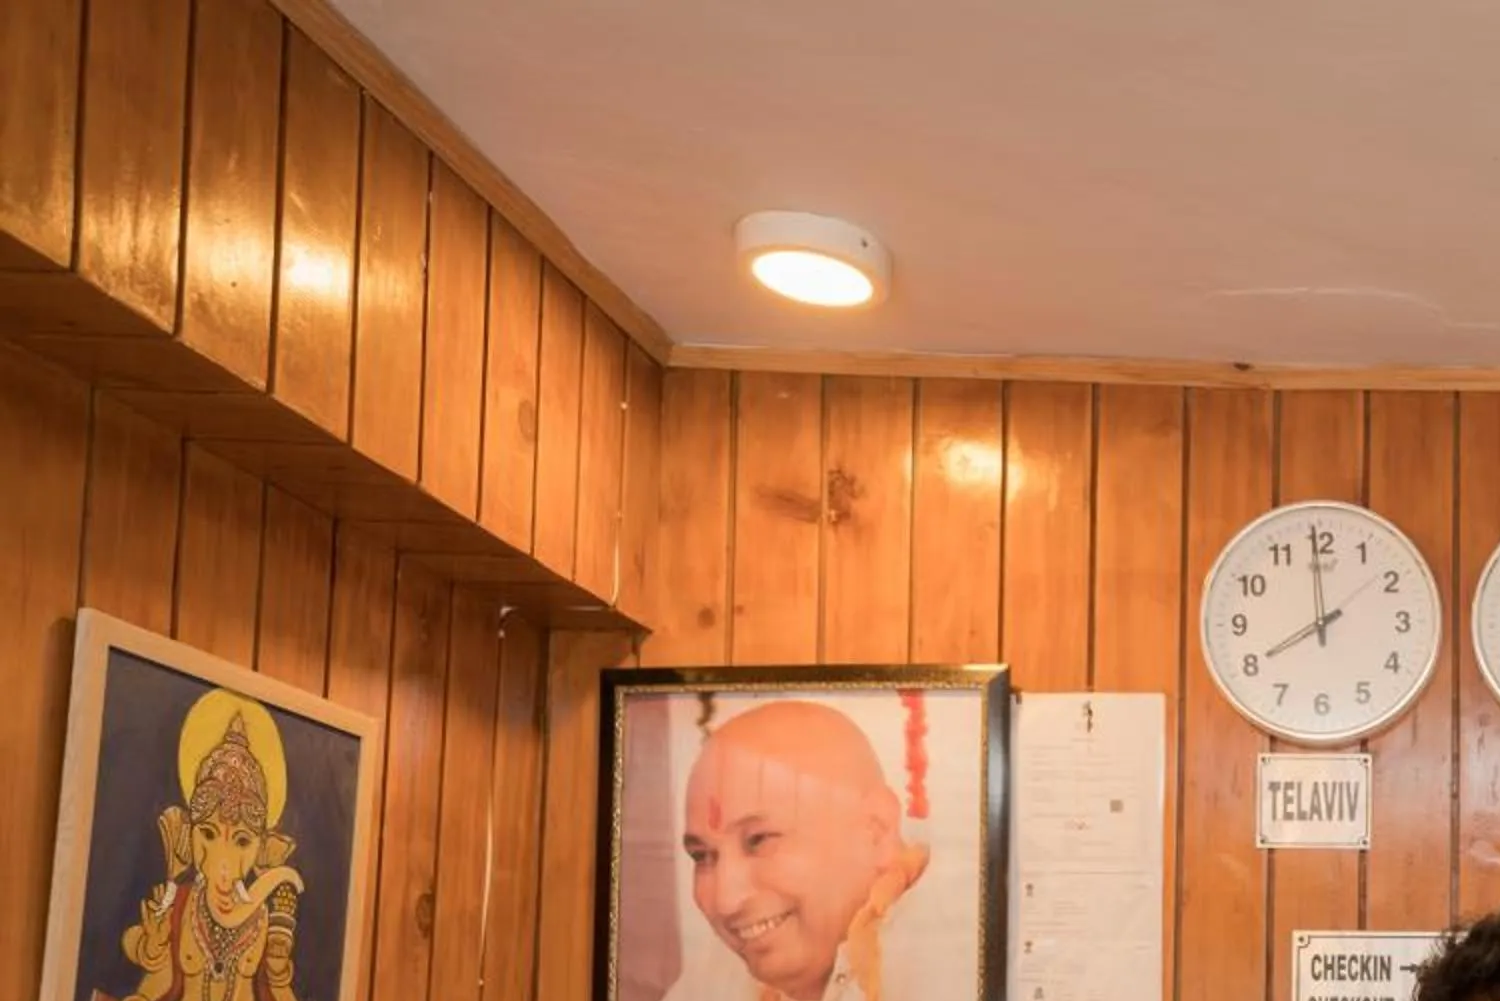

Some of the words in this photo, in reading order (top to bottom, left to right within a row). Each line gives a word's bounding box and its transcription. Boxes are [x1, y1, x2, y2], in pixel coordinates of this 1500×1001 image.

[1307, 531, 1334, 554] 12
[1354, 543, 1367, 564] 1
[1269, 544, 1292, 565] 11
[1238, 574, 1265, 596] 10
[1383, 572, 1400, 592] 2
[1231, 614, 1248, 636] 9
[1395, 612, 1411, 632] 3
[1242, 654, 1259, 676] 8
[1384, 652, 1400, 673] 4
[1273, 684, 1289, 706] 7
[1313, 693, 1331, 715] 6
[1355, 682, 1372, 704] 5
[1268, 781, 1360, 822] TELAVIV
[1311, 955, 1392, 981] CHECKIN
